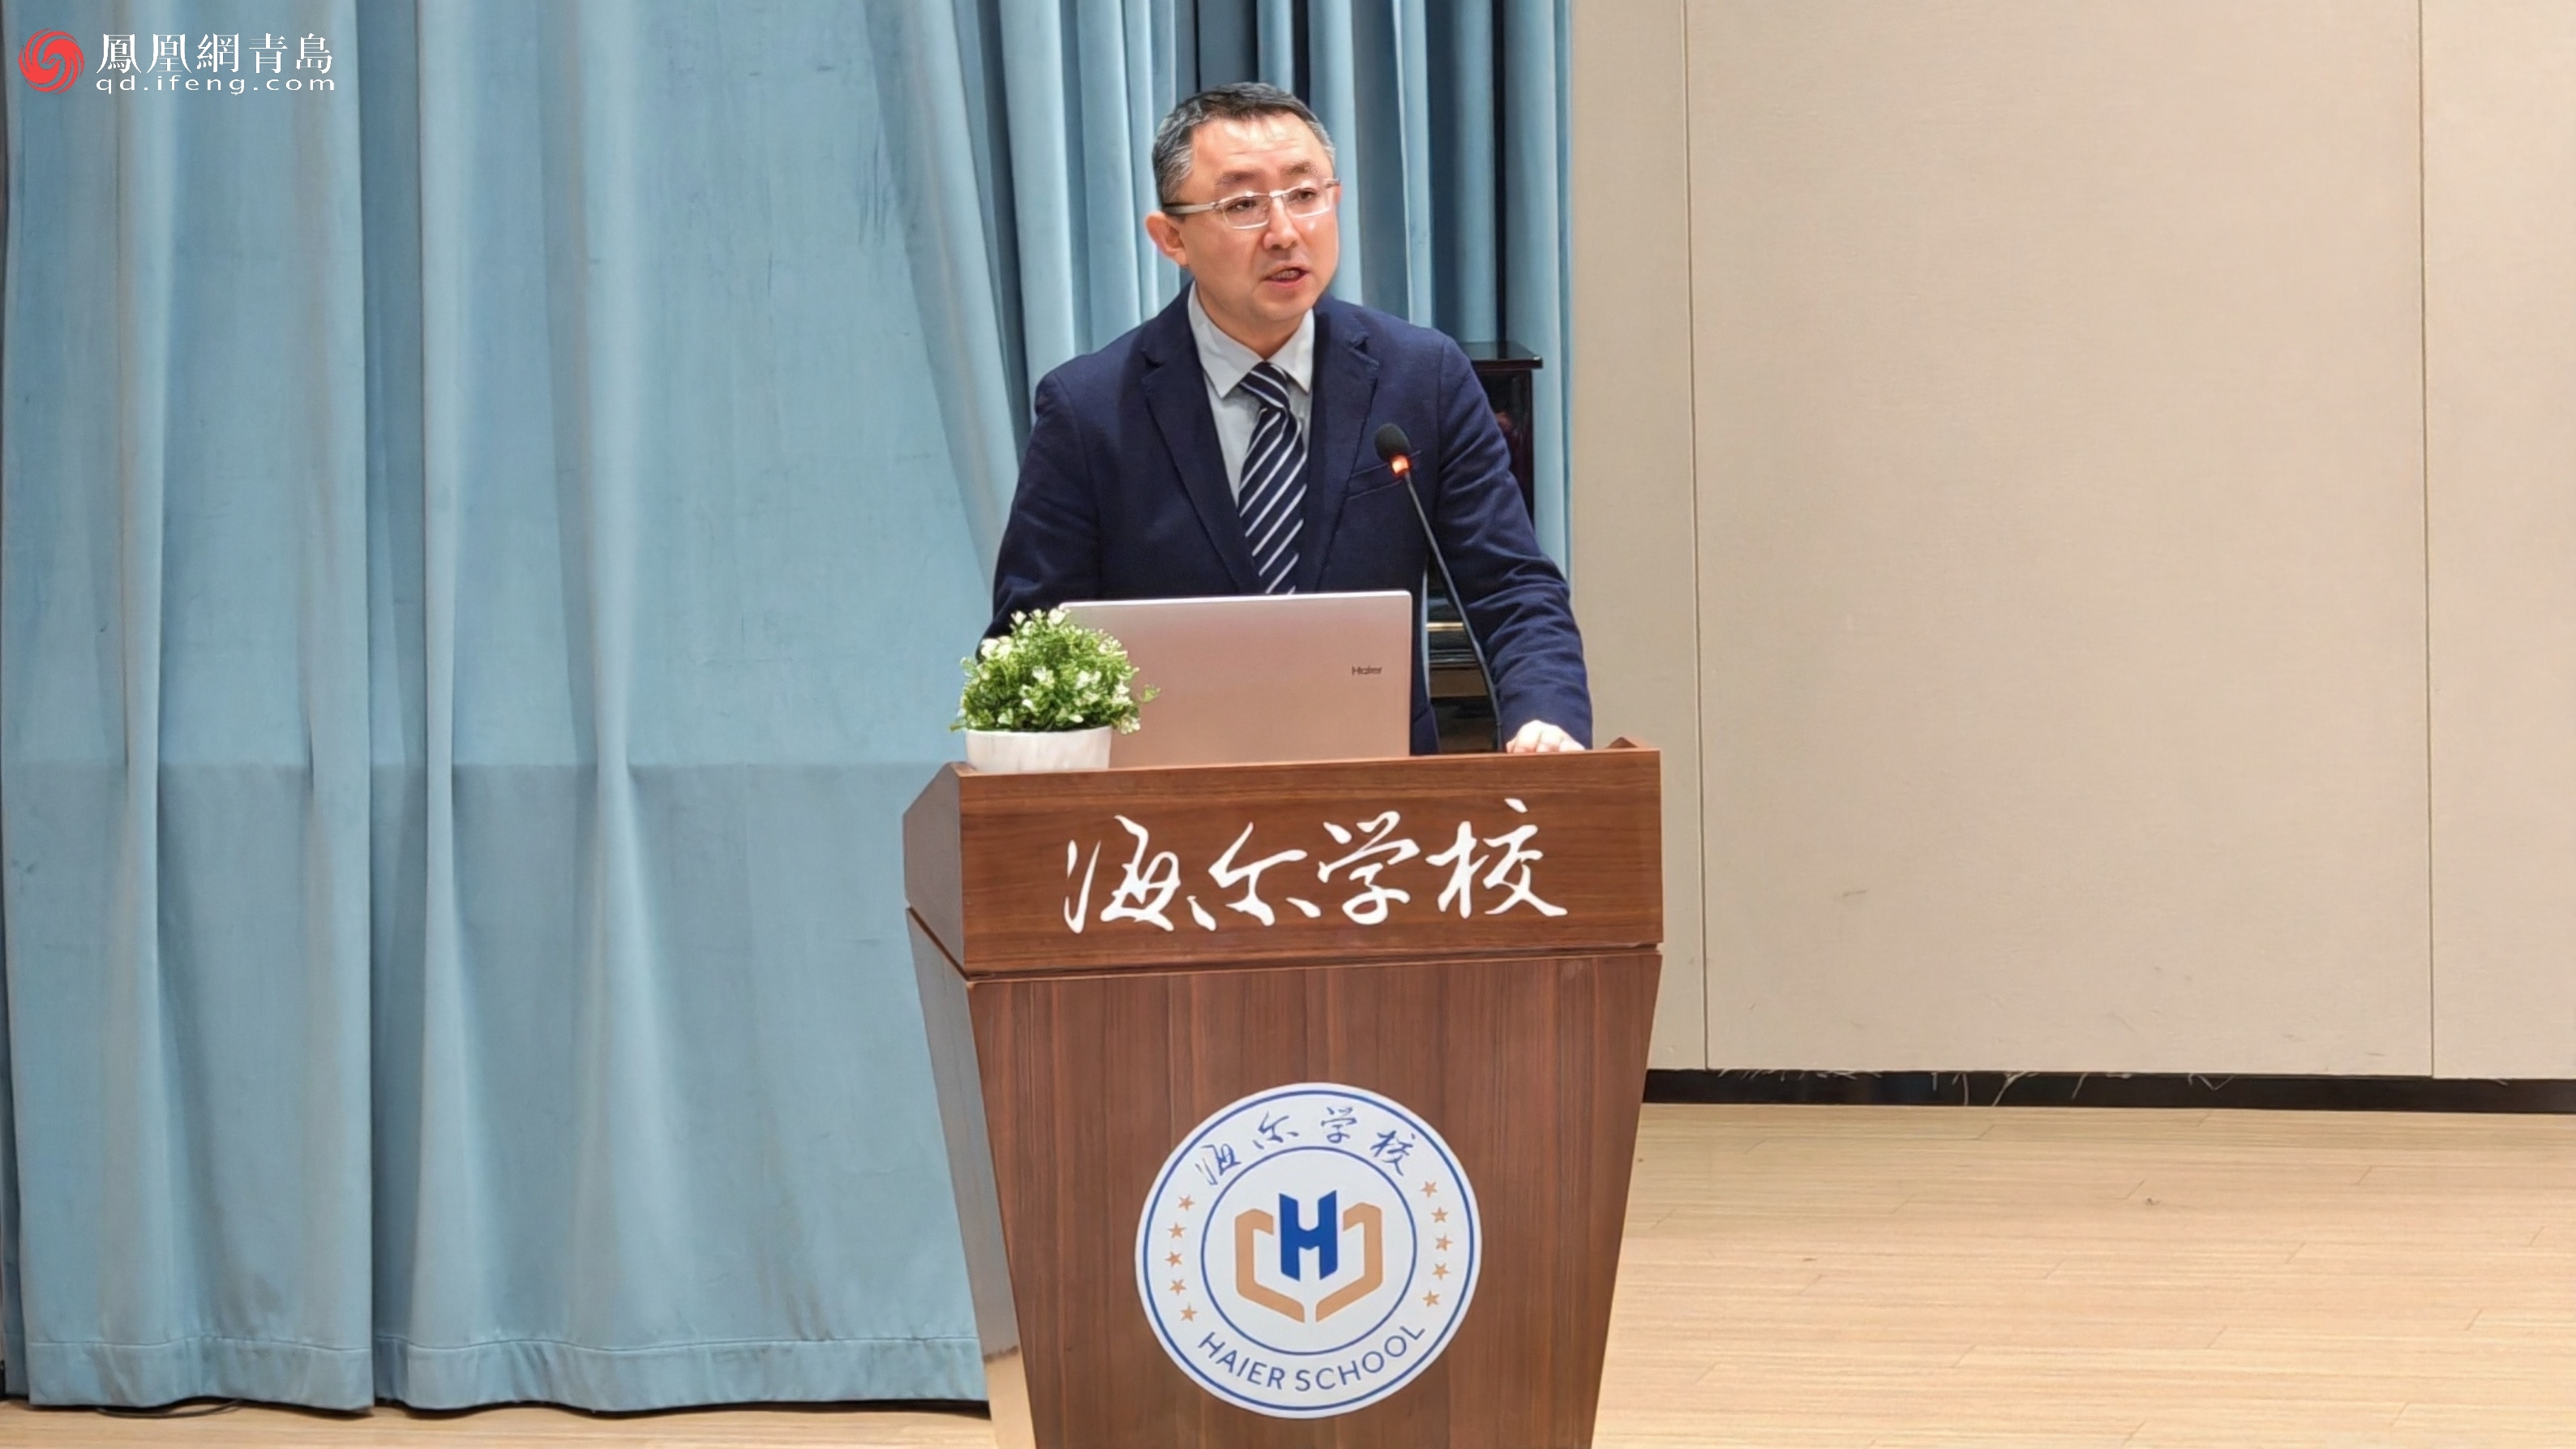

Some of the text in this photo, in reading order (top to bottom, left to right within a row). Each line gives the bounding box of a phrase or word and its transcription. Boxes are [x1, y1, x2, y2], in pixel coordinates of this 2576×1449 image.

[1064, 797, 1568, 934] 海尔学校
[1195, 1105, 1417, 1185] 海尔学校
[1197, 1325, 1426, 1391] HAIER SCHOOL
